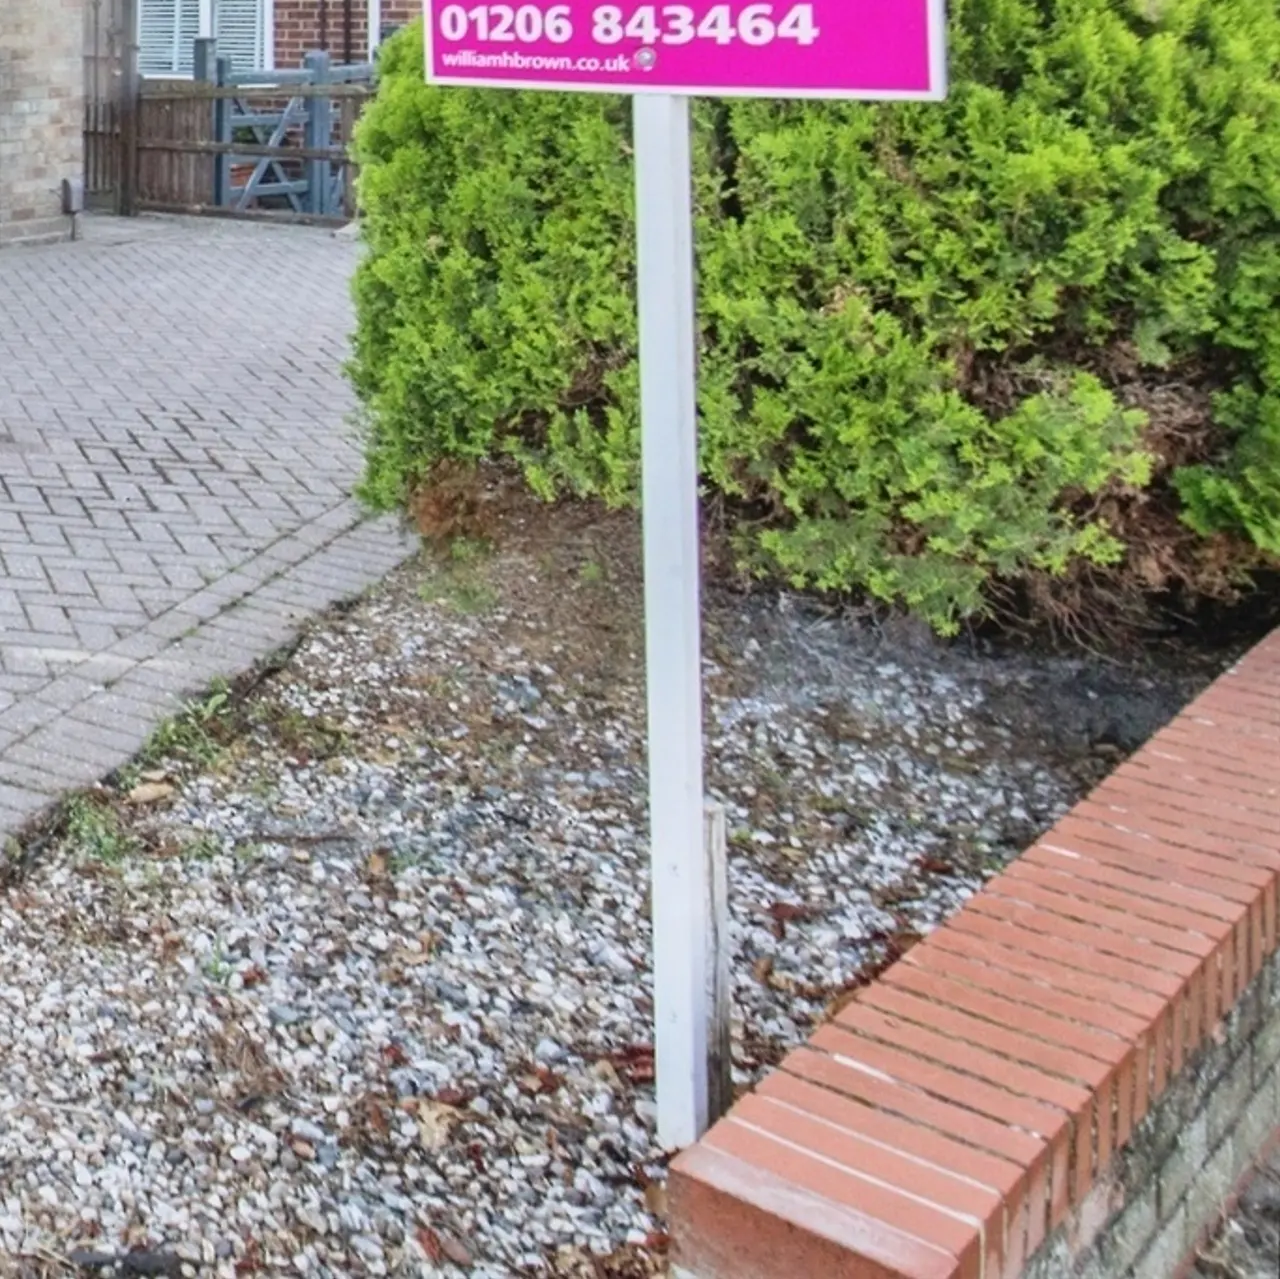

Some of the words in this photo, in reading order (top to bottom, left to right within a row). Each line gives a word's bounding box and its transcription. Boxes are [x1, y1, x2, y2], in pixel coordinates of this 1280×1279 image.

[439, 3, 573, 44] 01206
[591, 3, 820, 46] 843464
[441, 49, 631, 73] williamhbrown.co.uk
